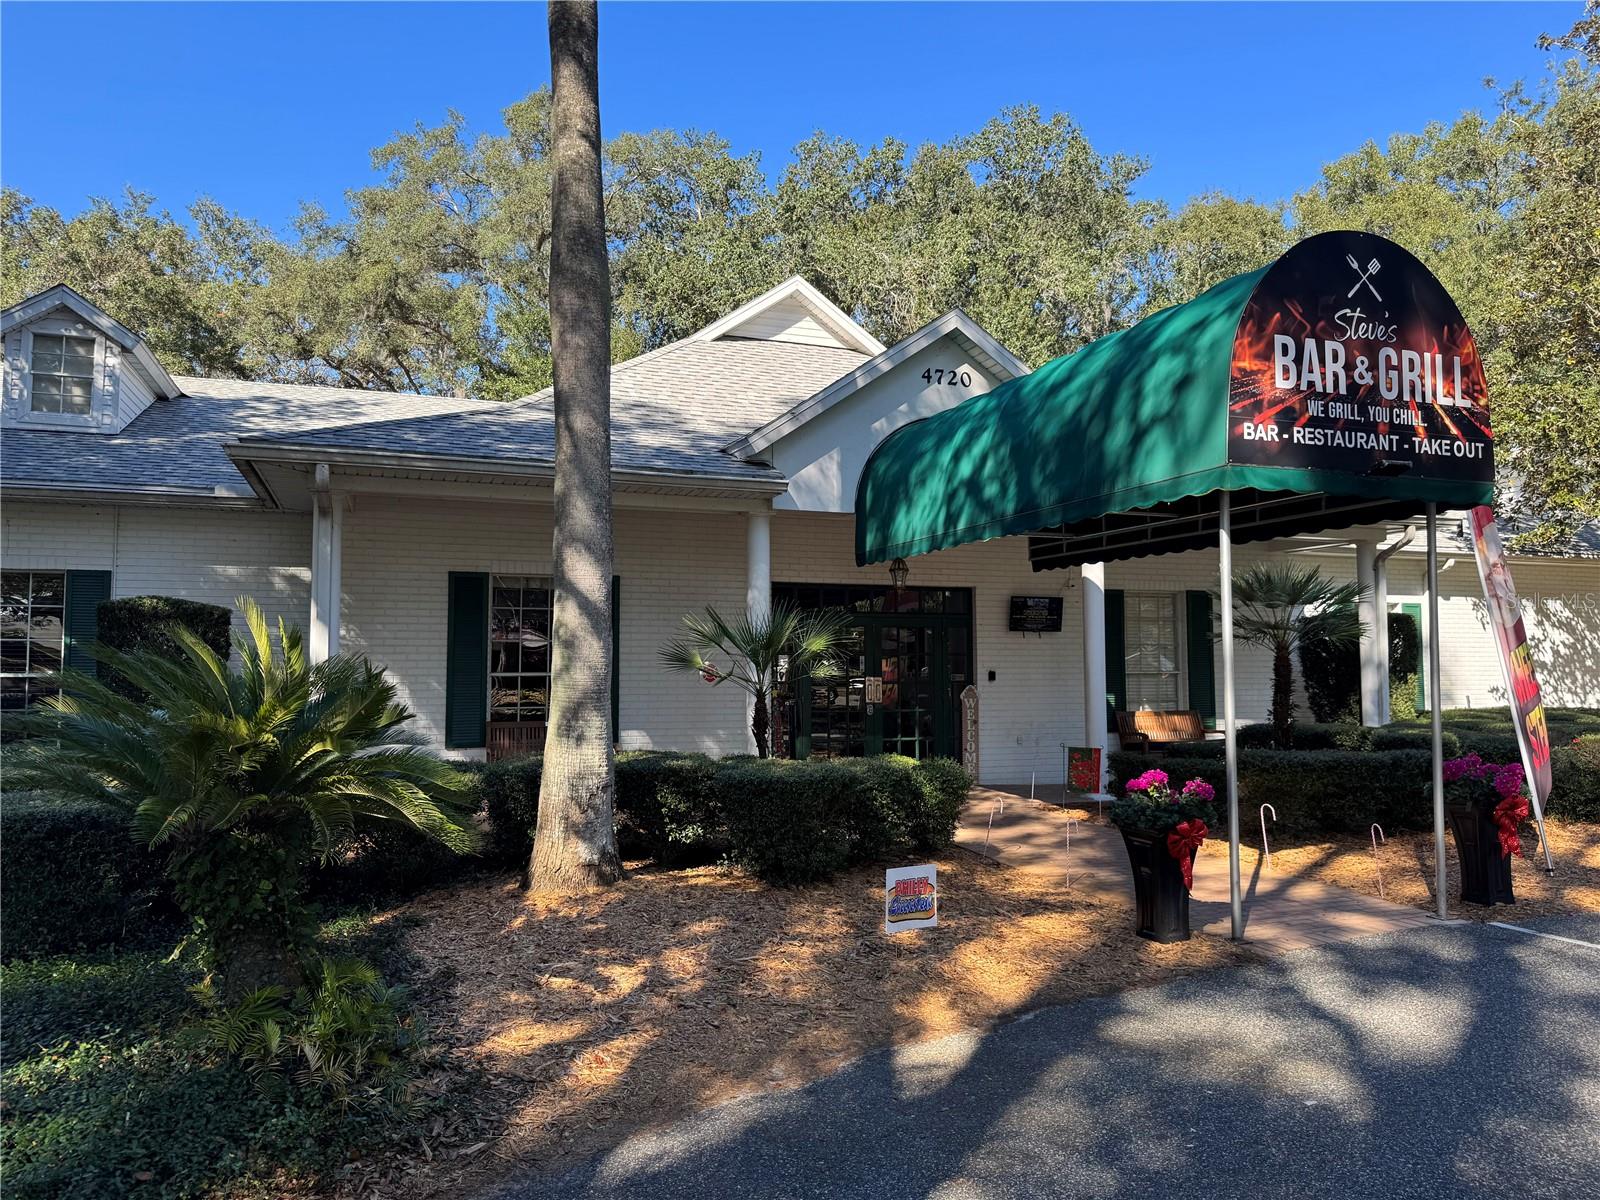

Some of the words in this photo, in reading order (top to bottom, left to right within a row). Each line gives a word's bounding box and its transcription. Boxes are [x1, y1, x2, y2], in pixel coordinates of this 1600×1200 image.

[1333, 307, 1398, 343] Steve's
[921, 367, 972, 388] 4720
[1273, 334, 1347, 395] BAR
[1353, 356, 1374, 386] &
[1378, 346, 1472, 408] GRILL
[1307, 399, 1325, 418] WE
[1328, 402, 1365, 423] GRILL,
[1368, 405, 1390, 423] YOU
[1392, 407, 1428, 427] CHILL.
[1243, 422, 1280, 442] BAR
[1293, 426, 1400, 452] RESTAURANT
[1412, 437, 1451, 456] TAKE
[1453, 440, 1484, 459] OUT
[964, 698, 977, 774] WELCOME
